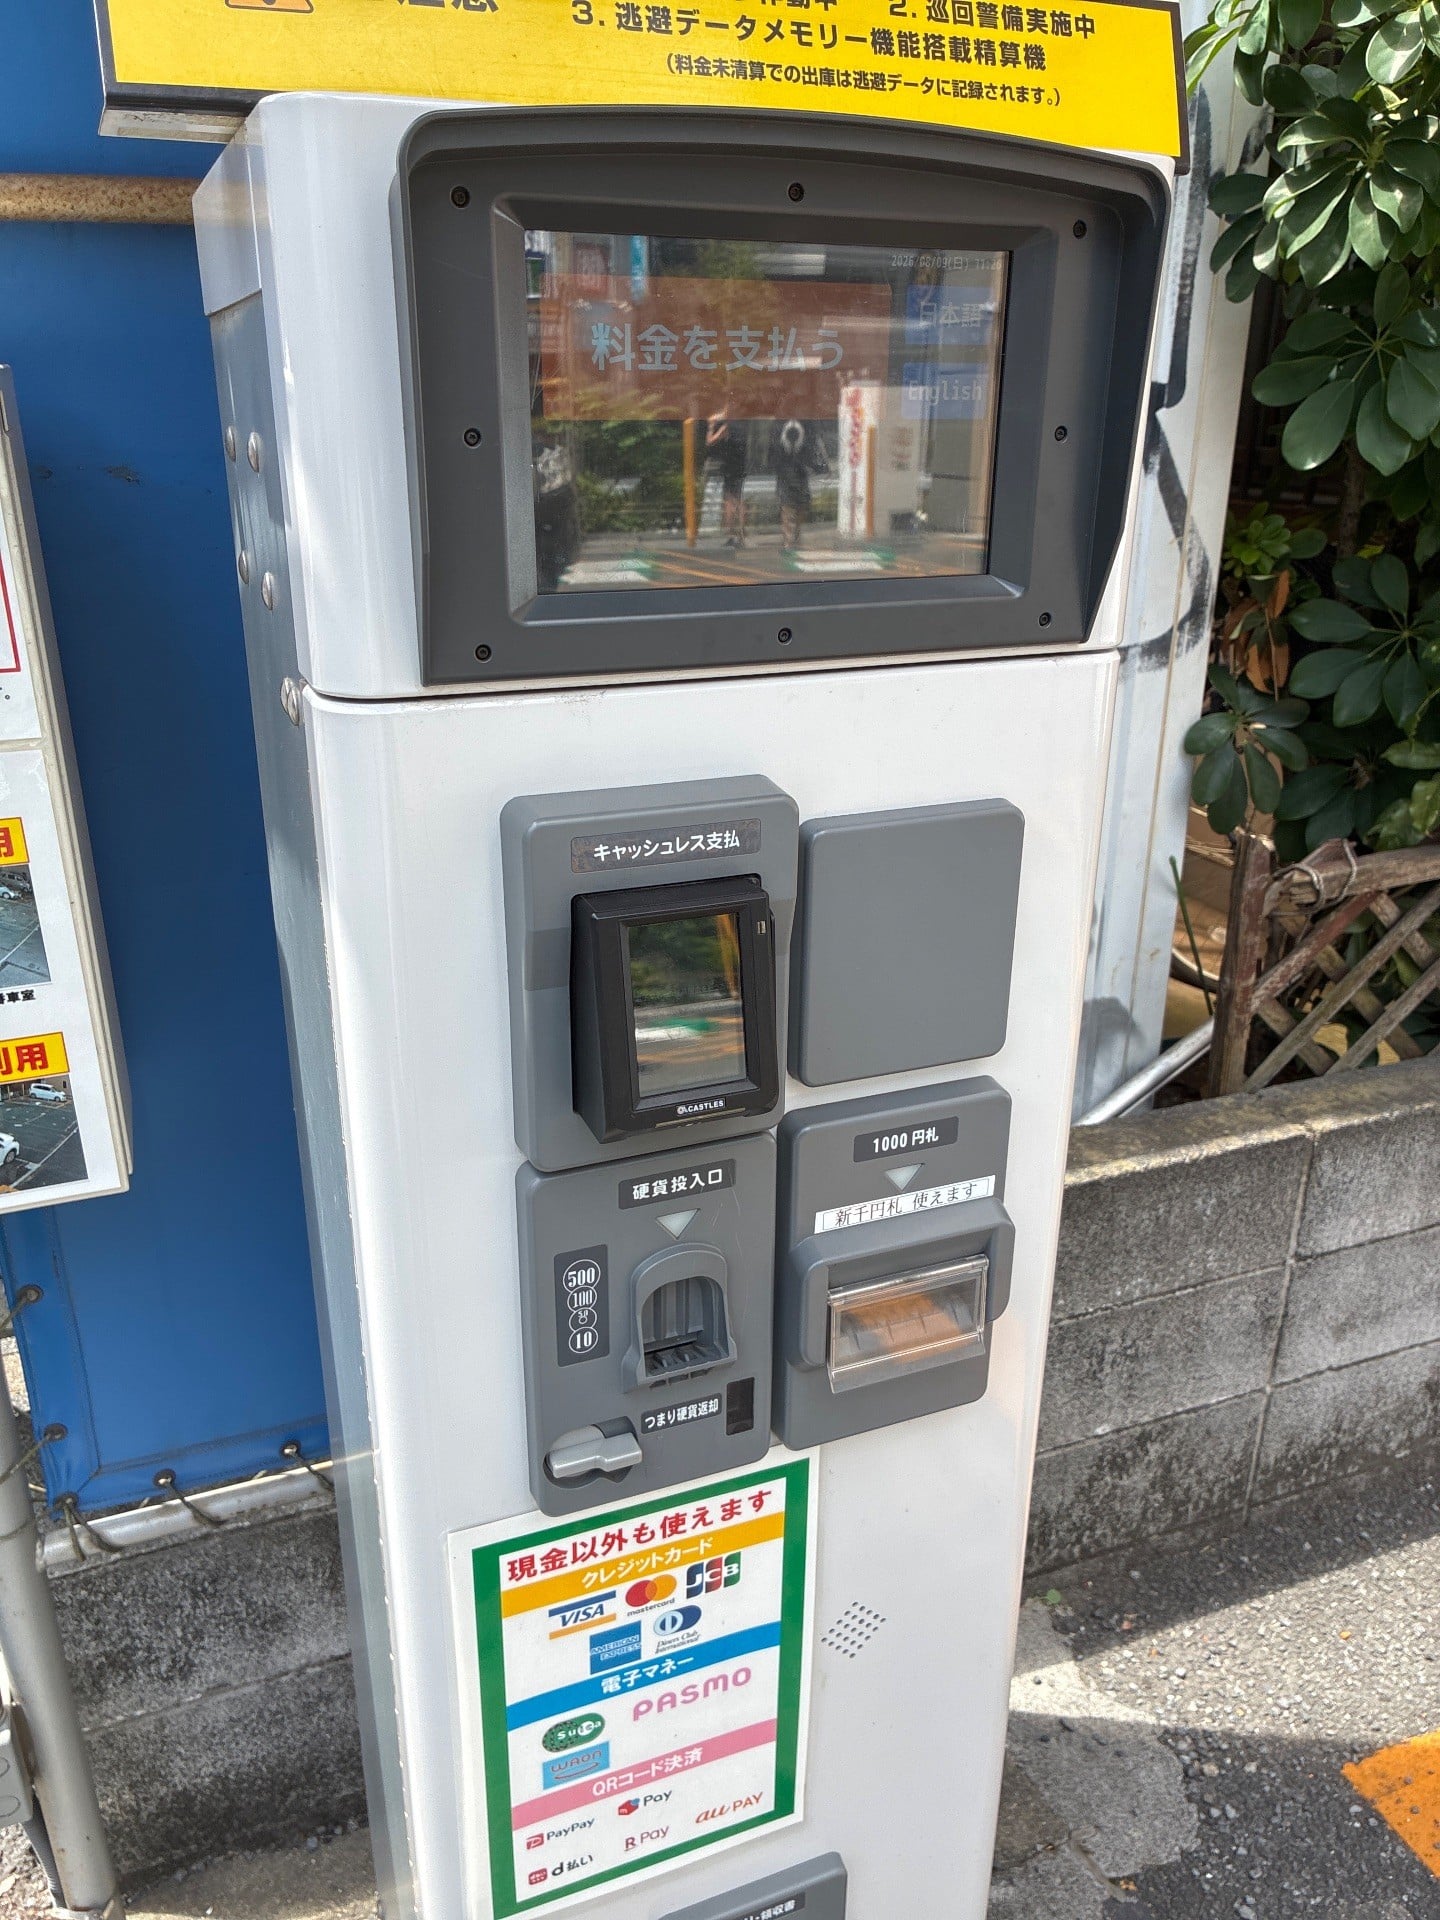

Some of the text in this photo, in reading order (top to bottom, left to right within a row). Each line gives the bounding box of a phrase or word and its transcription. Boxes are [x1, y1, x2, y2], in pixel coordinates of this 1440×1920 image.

[591, 323, 844, 371] 料金を支払う
[908, 379, 982, 405] English
[593, 829, 740, 862] キャッシュレス支払
[687, 1099, 724, 1114] CASTLES
[632, 1168, 723, 1200] 硬貨投入口
[835, 1182, 977, 1227] 新千円札 使えます
[567, 1267, 596, 1288] 500
[572, 1289, 593, 1309] 100
[575, 1332, 593, 1350] 10
[645, 1398, 719, 1429] つまり硬貨返却
[507, 1490, 772, 1582] 現金以外も使えます
[582, 1537, 713, 1589] クレジットカード
[687, 1552, 741, 1599] JCB
[559, 1604, 605, 1627] VISA
[627, 1598, 675, 1617] mastercard
[601, 1657, 695, 1694] 電子マネー
[633, 1667, 751, 1721] PASMO
[592, 1747, 703, 1796] QRコード決済
[643, 1790, 673, 1806] Pay
[732, 1791, 764, 1813] PAY
[546, 1818, 595, 1841] PayPay
[640, 1826, 670, 1844] Pay
